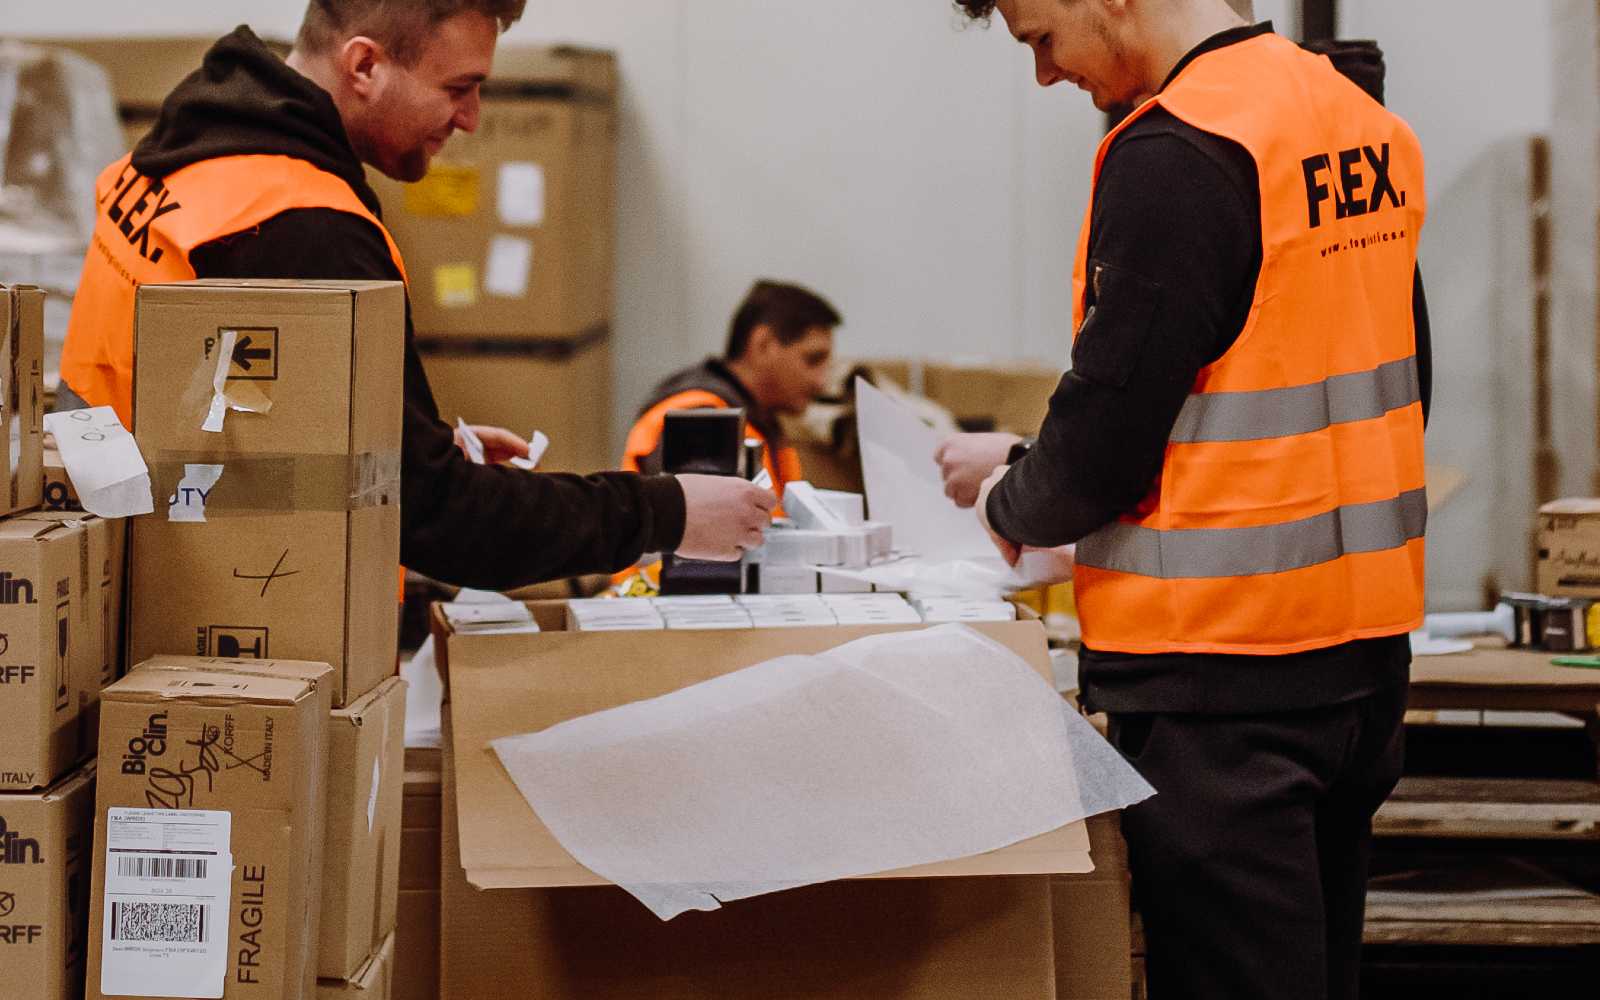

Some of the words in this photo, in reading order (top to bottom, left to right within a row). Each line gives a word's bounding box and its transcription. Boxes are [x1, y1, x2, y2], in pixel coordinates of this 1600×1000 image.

[1302, 143, 1406, 229] FLEX.
[223, 713, 236, 753] KORFF
[264, 716, 274, 740] ITALY
[121, 736, 147, 775] Bio
[262, 753, 272, 782] MADE
[1, 772, 35, 784] ITALY
[0, 831, 45, 864] lin.
[237, 865, 266, 984] FRAGILE
